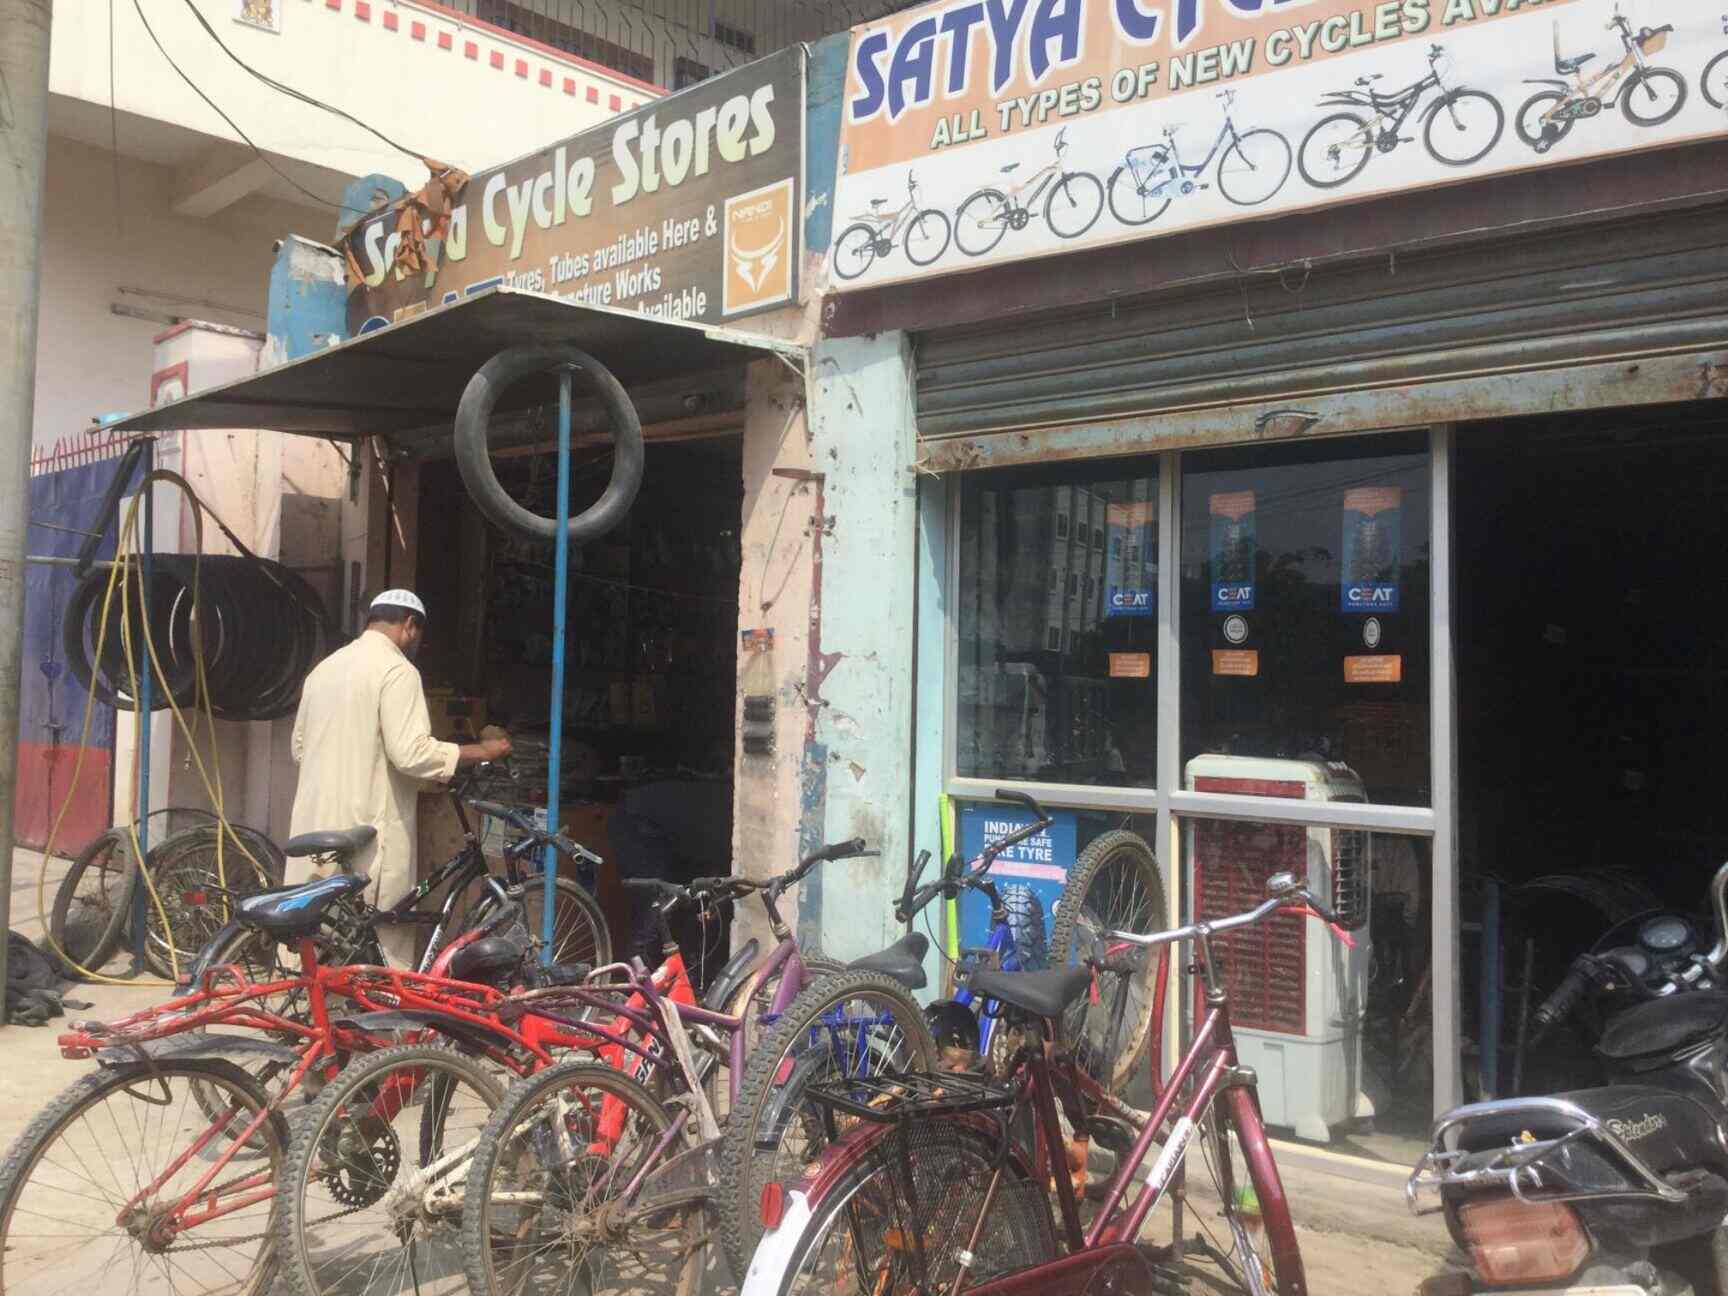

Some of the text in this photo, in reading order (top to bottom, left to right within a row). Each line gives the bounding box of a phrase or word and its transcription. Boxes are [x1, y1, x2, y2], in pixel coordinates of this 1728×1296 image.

[852, 0, 1086, 119] SATYA
[929, 115, 987, 150] ALL
[999, 77, 1103, 131] TYPES
[1111, 62, 1160, 102] OF
[1168, 37, 1256, 90] NEW
[1265, 0, 1431, 67] CYCLES
[482, 147, 596, 260] Cycle
[611, 83, 776, 206] Stores
[550, 252, 589, 285] Tubes
[593, 226, 658, 270] available
[662, 218, 700, 250] Here
[704, 204, 718, 237] &
[616, 263, 662, 300] Works
[1018, 847, 1053, 861] TYRE
[1030, 837, 1053, 849] SAFE
